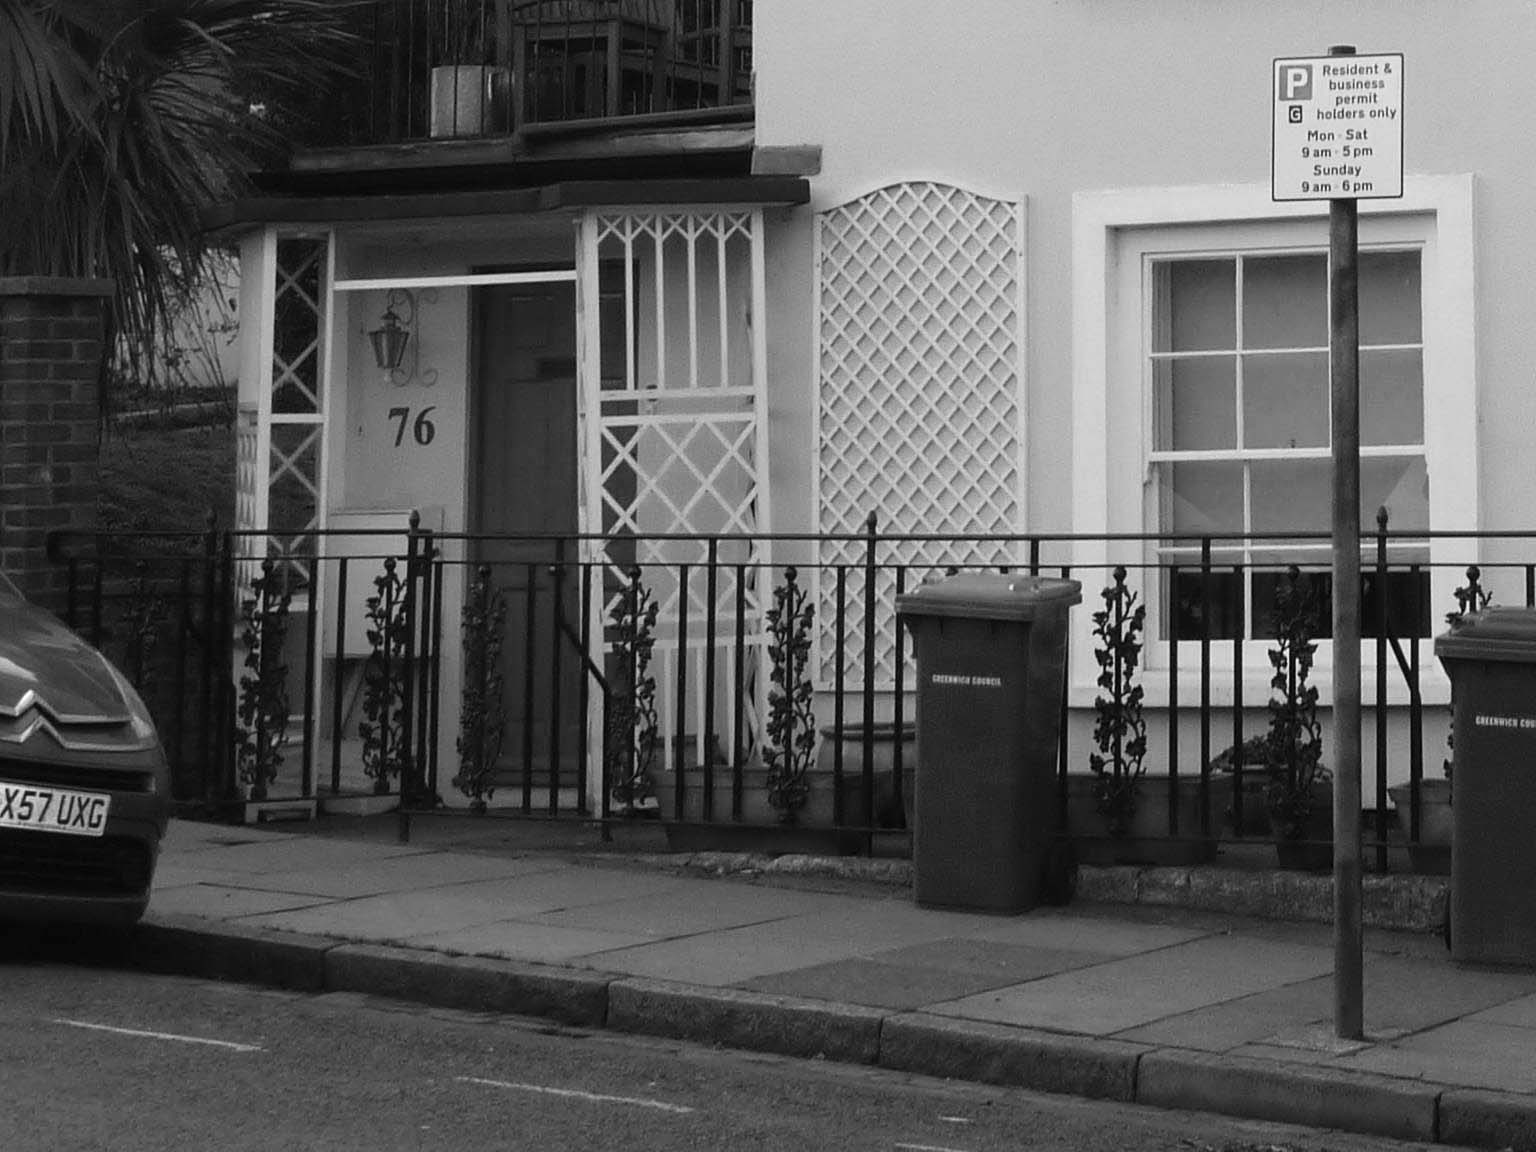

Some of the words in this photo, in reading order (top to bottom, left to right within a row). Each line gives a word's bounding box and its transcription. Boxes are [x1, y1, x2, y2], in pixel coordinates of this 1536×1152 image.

[1322, 64, 1379, 77] Resident
[1383, 63, 1392, 74] &
[1287, 68, 1308, 98] P
[1329, 79, 1385, 90] business
[1336, 93, 1378, 106] permit
[1290, 106, 1302, 122] G
[1317, 108, 1365, 120] holders
[1369, 107, 1397, 119] only
[1307, 130, 1335, 142] Mon
[1345, 129, 1369, 140] Sat
[1313, 165, 1362, 177] Sunday
[388, 405, 437, 447] 76
[0, 788, 53, 822] X57
[57, 795, 105, 828] UXG
